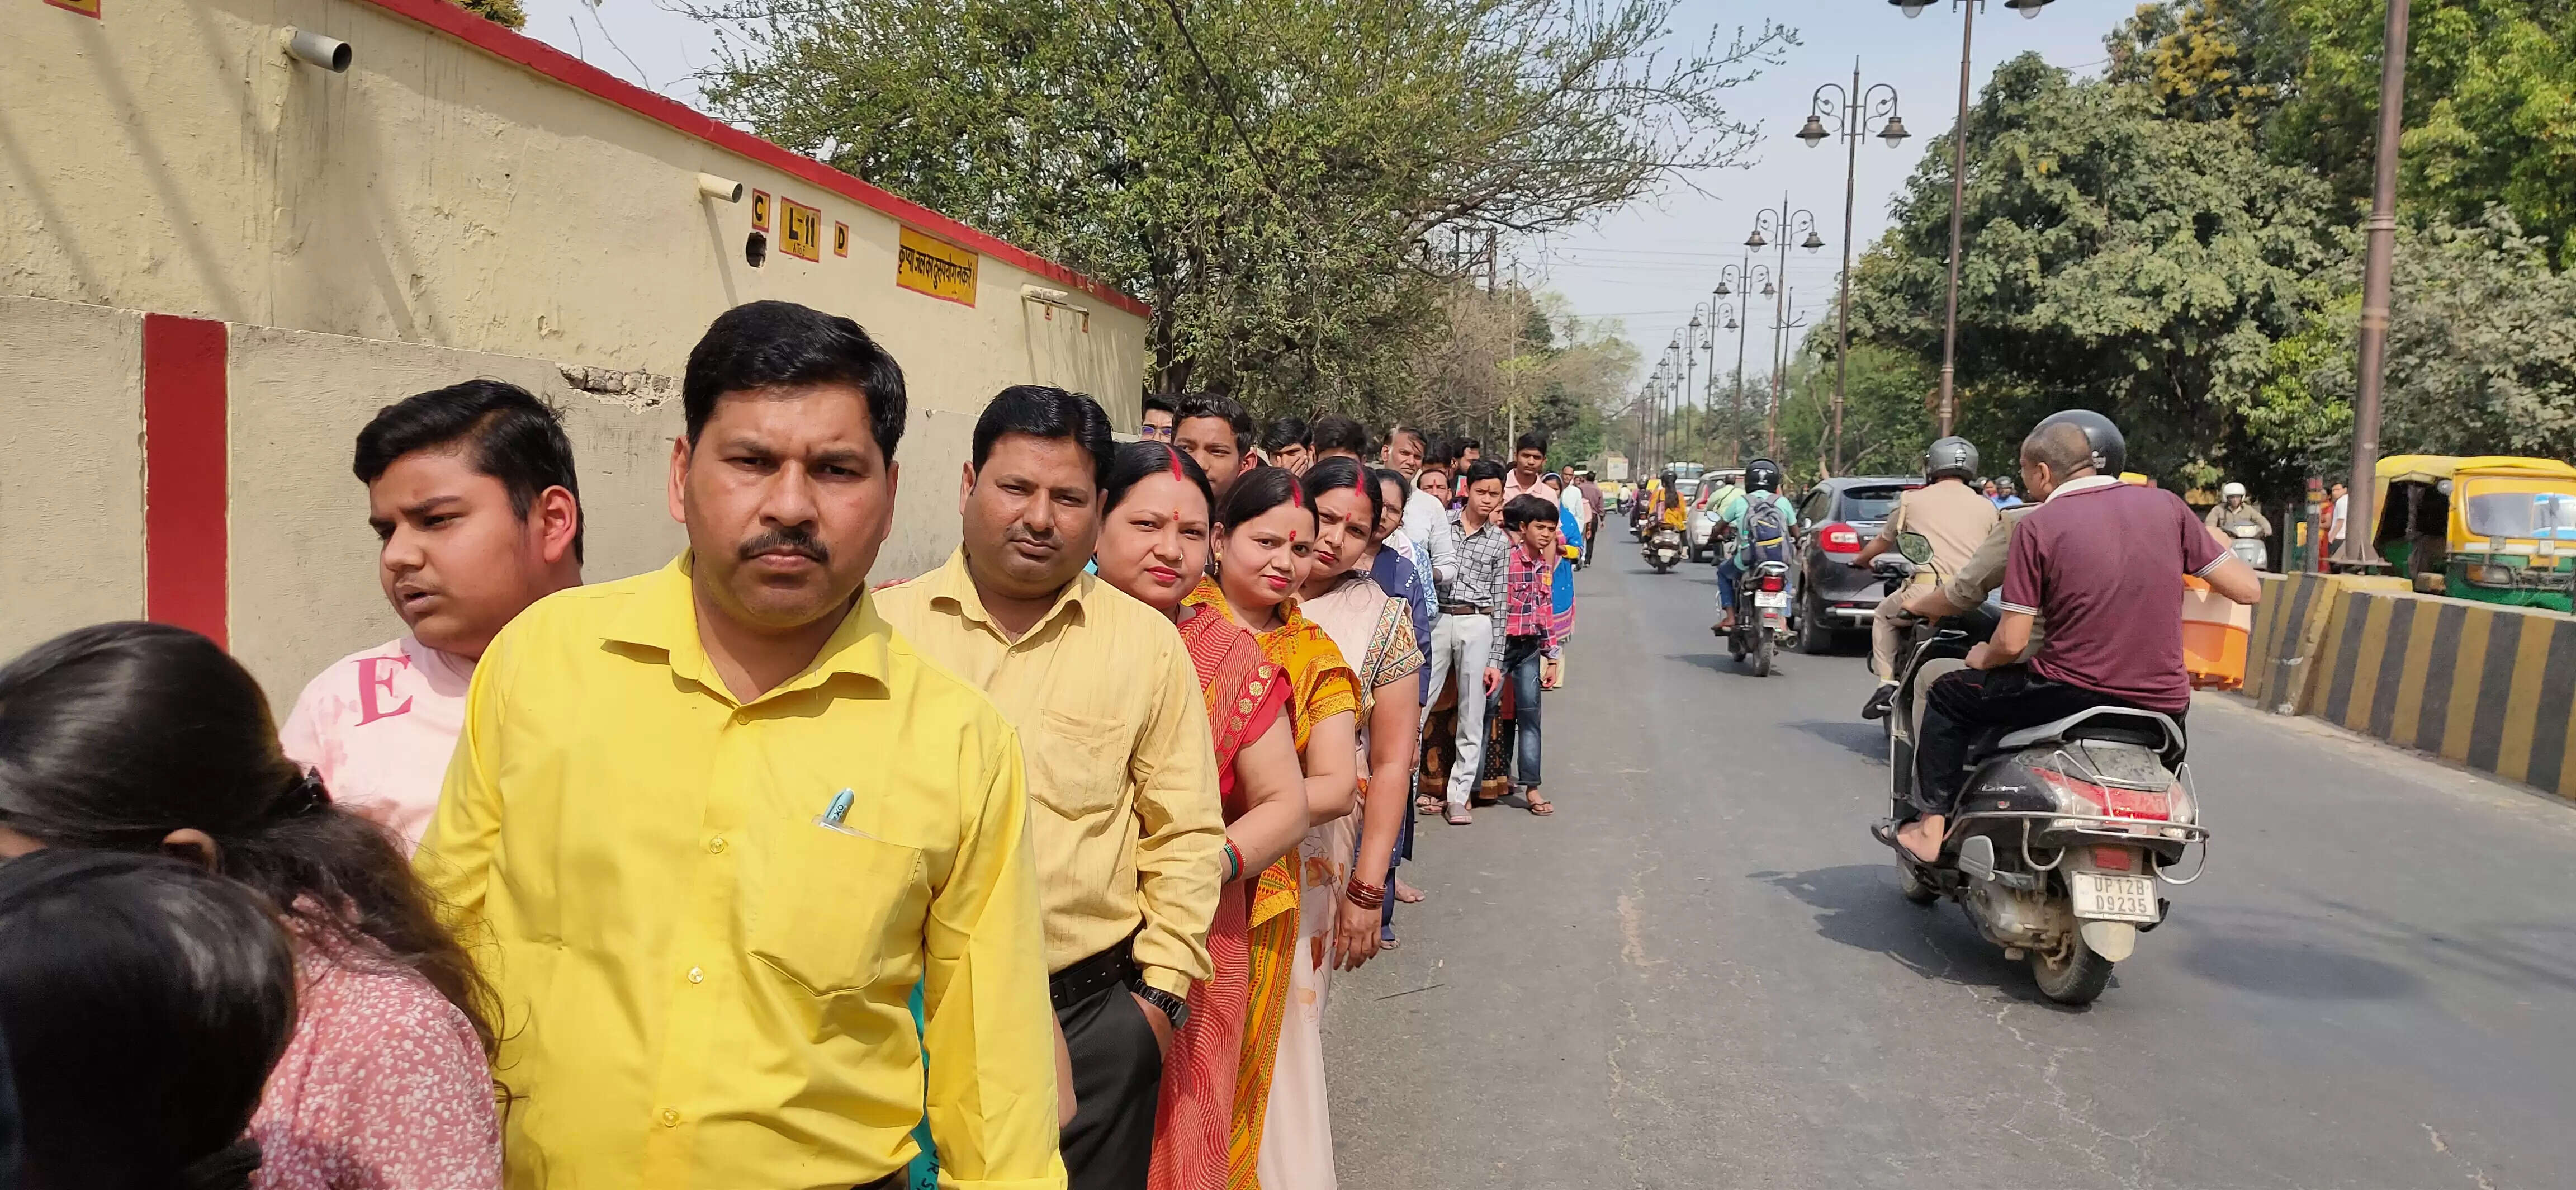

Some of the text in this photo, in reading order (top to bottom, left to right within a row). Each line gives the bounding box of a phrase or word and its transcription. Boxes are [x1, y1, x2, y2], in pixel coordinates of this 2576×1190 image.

[755, 195, 763, 222] C
[789, 207, 815, 248] L-11
[838, 226, 845, 249] D
[914, 251, 926, 276] जल
[926, 254, 934, 279] का
[351, 655, 413, 726] E
[2094, 877, 2144, 895] UP12B
[2096, 895, 2147, 913] D9235
